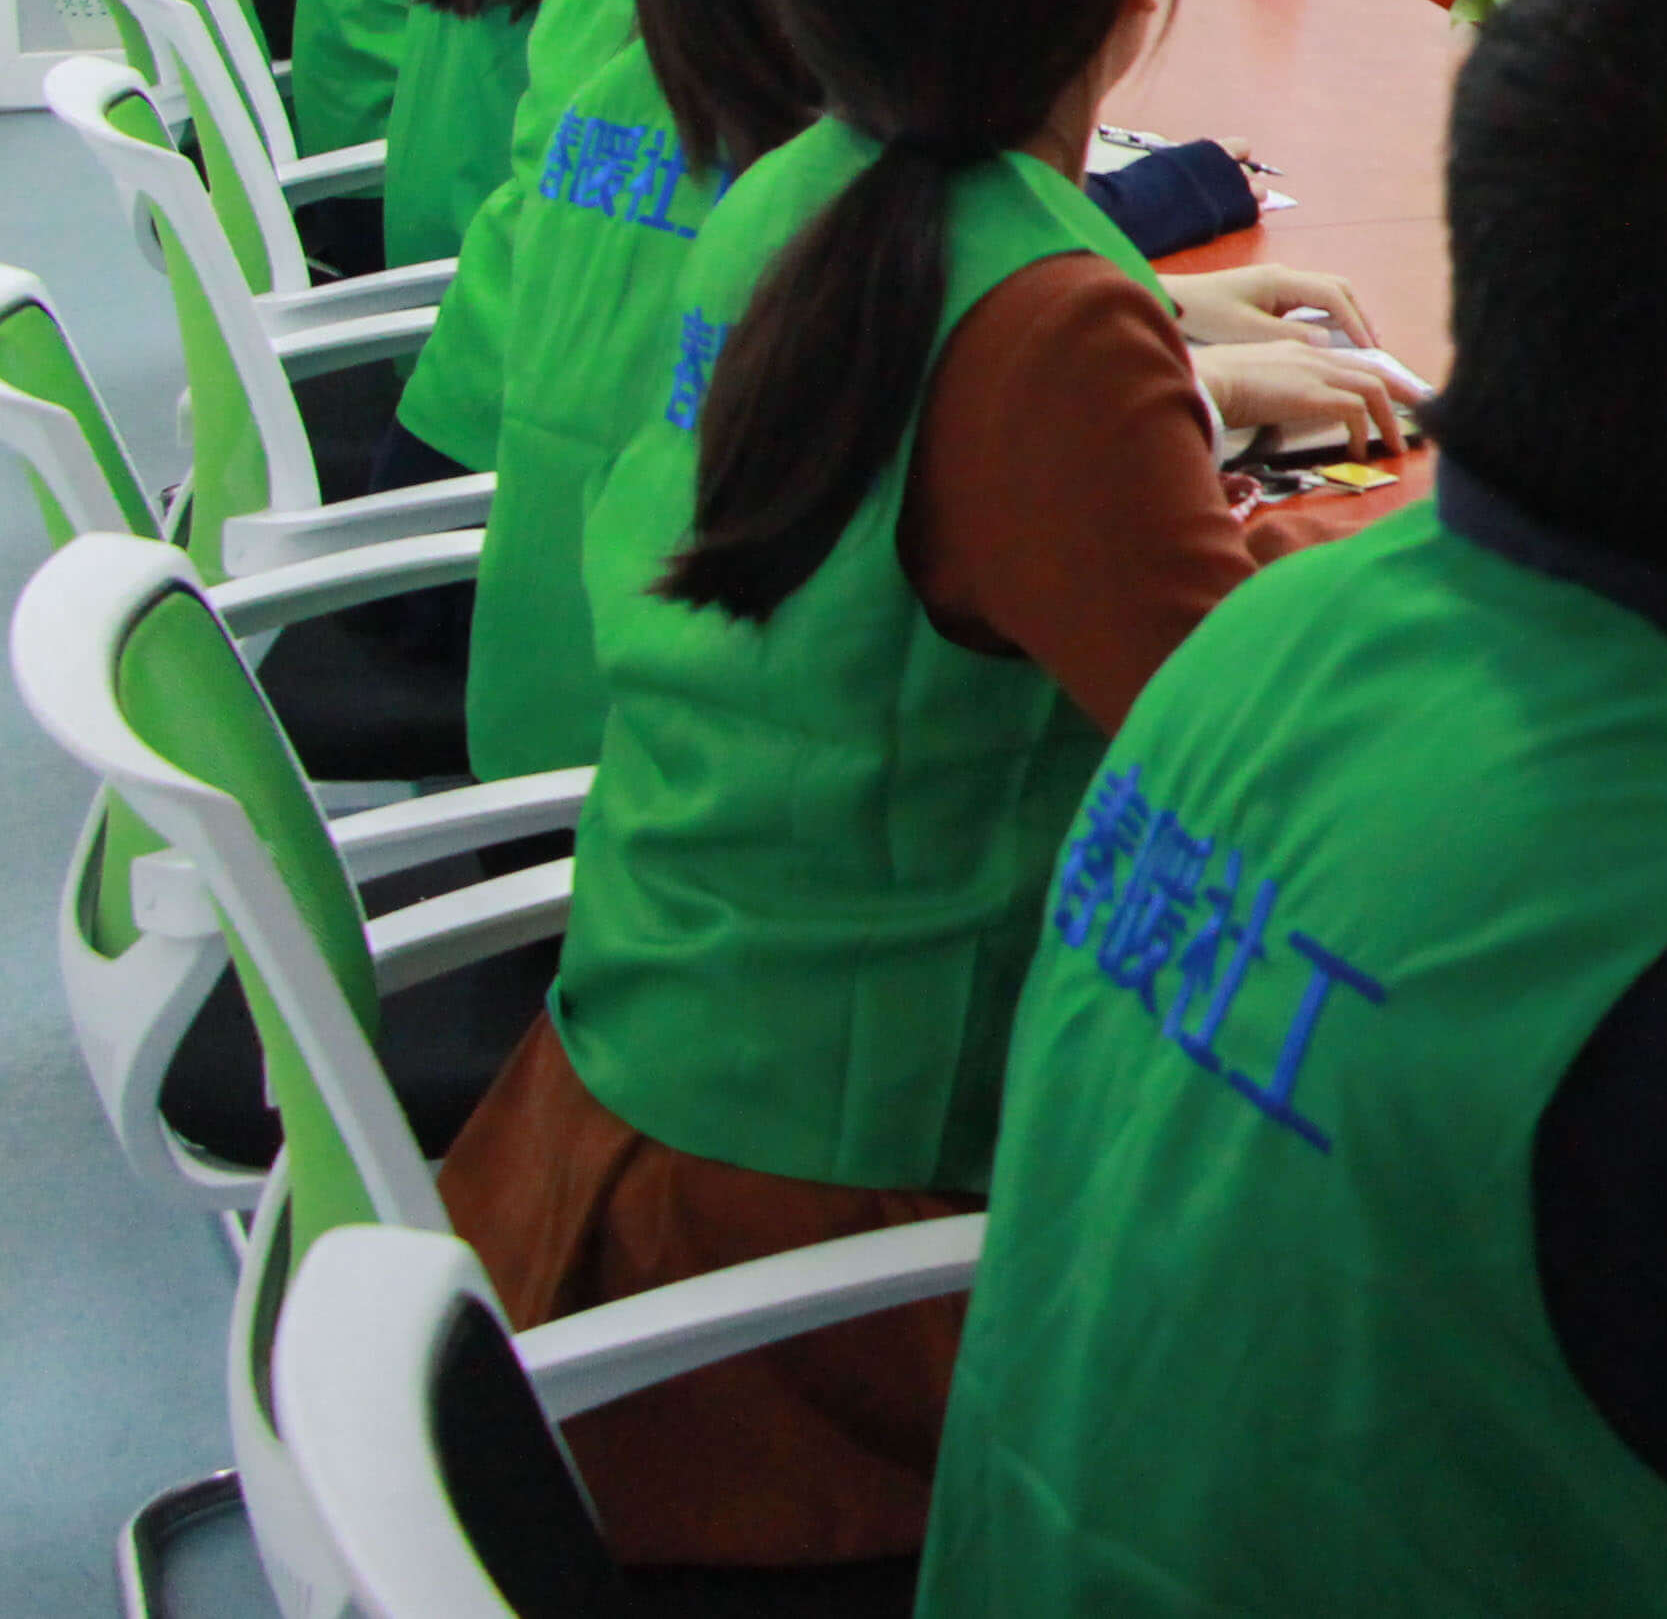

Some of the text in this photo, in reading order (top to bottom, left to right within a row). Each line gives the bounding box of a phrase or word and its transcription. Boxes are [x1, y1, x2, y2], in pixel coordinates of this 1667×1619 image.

[664, 304, 728, 430] 春
[1055, 764, 1388, 1154] 春暖社工
